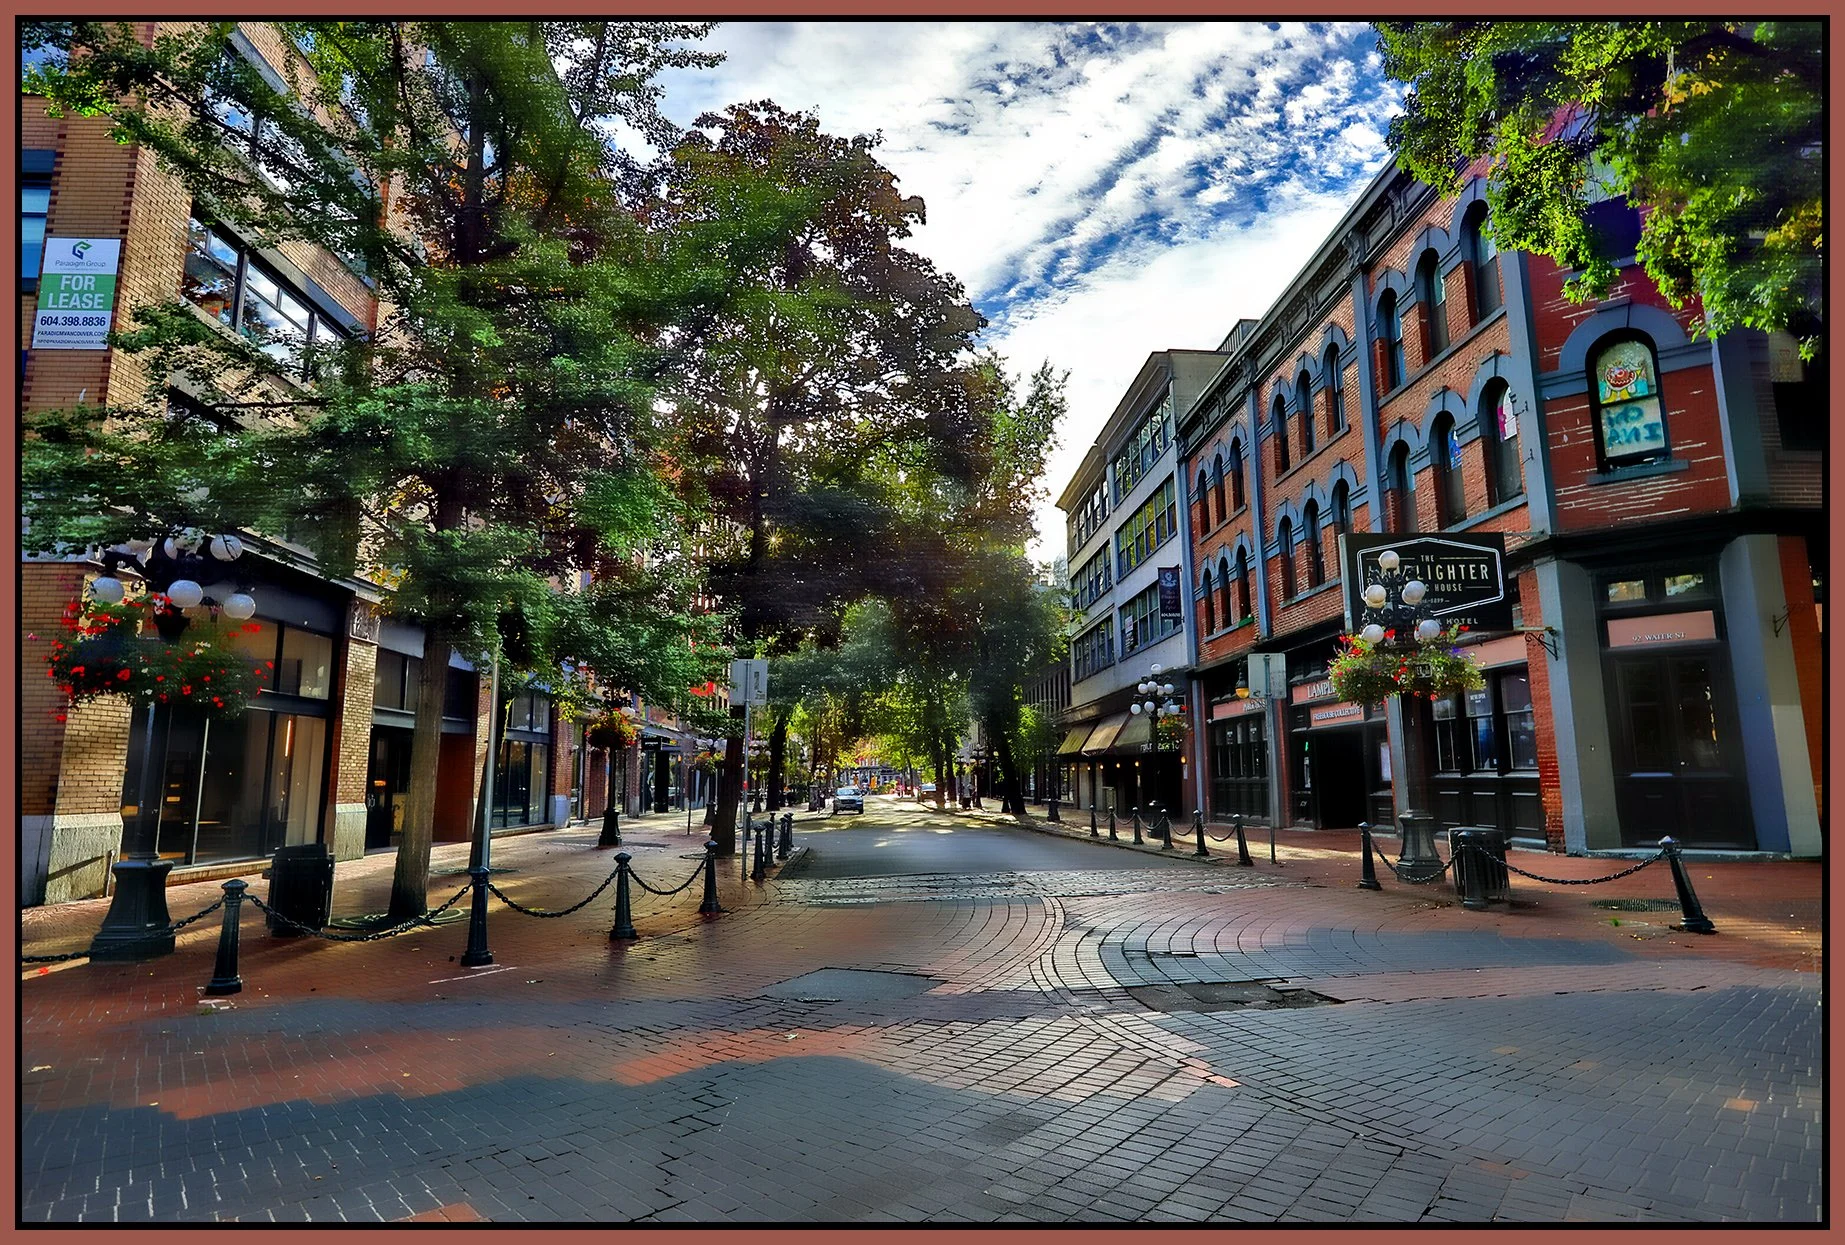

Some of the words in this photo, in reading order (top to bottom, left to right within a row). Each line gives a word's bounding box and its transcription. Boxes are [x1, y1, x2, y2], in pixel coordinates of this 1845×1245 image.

[55, 260, 85, 268] Paradigm
[86, 260, 106, 268] Group
[60, 275, 96, 291] FOR
[47, 292, 105, 309] LEASE
[40, 315, 106, 327] 604.398.8836
[1420, 555, 1435, 563] THE
[1434, 583, 1463, 593] HOUSE
[1446, 617, 1479, 625] HOTEL
[1644, 633, 1673, 641] WATER
[1674, 631, 1687, 639] ST
